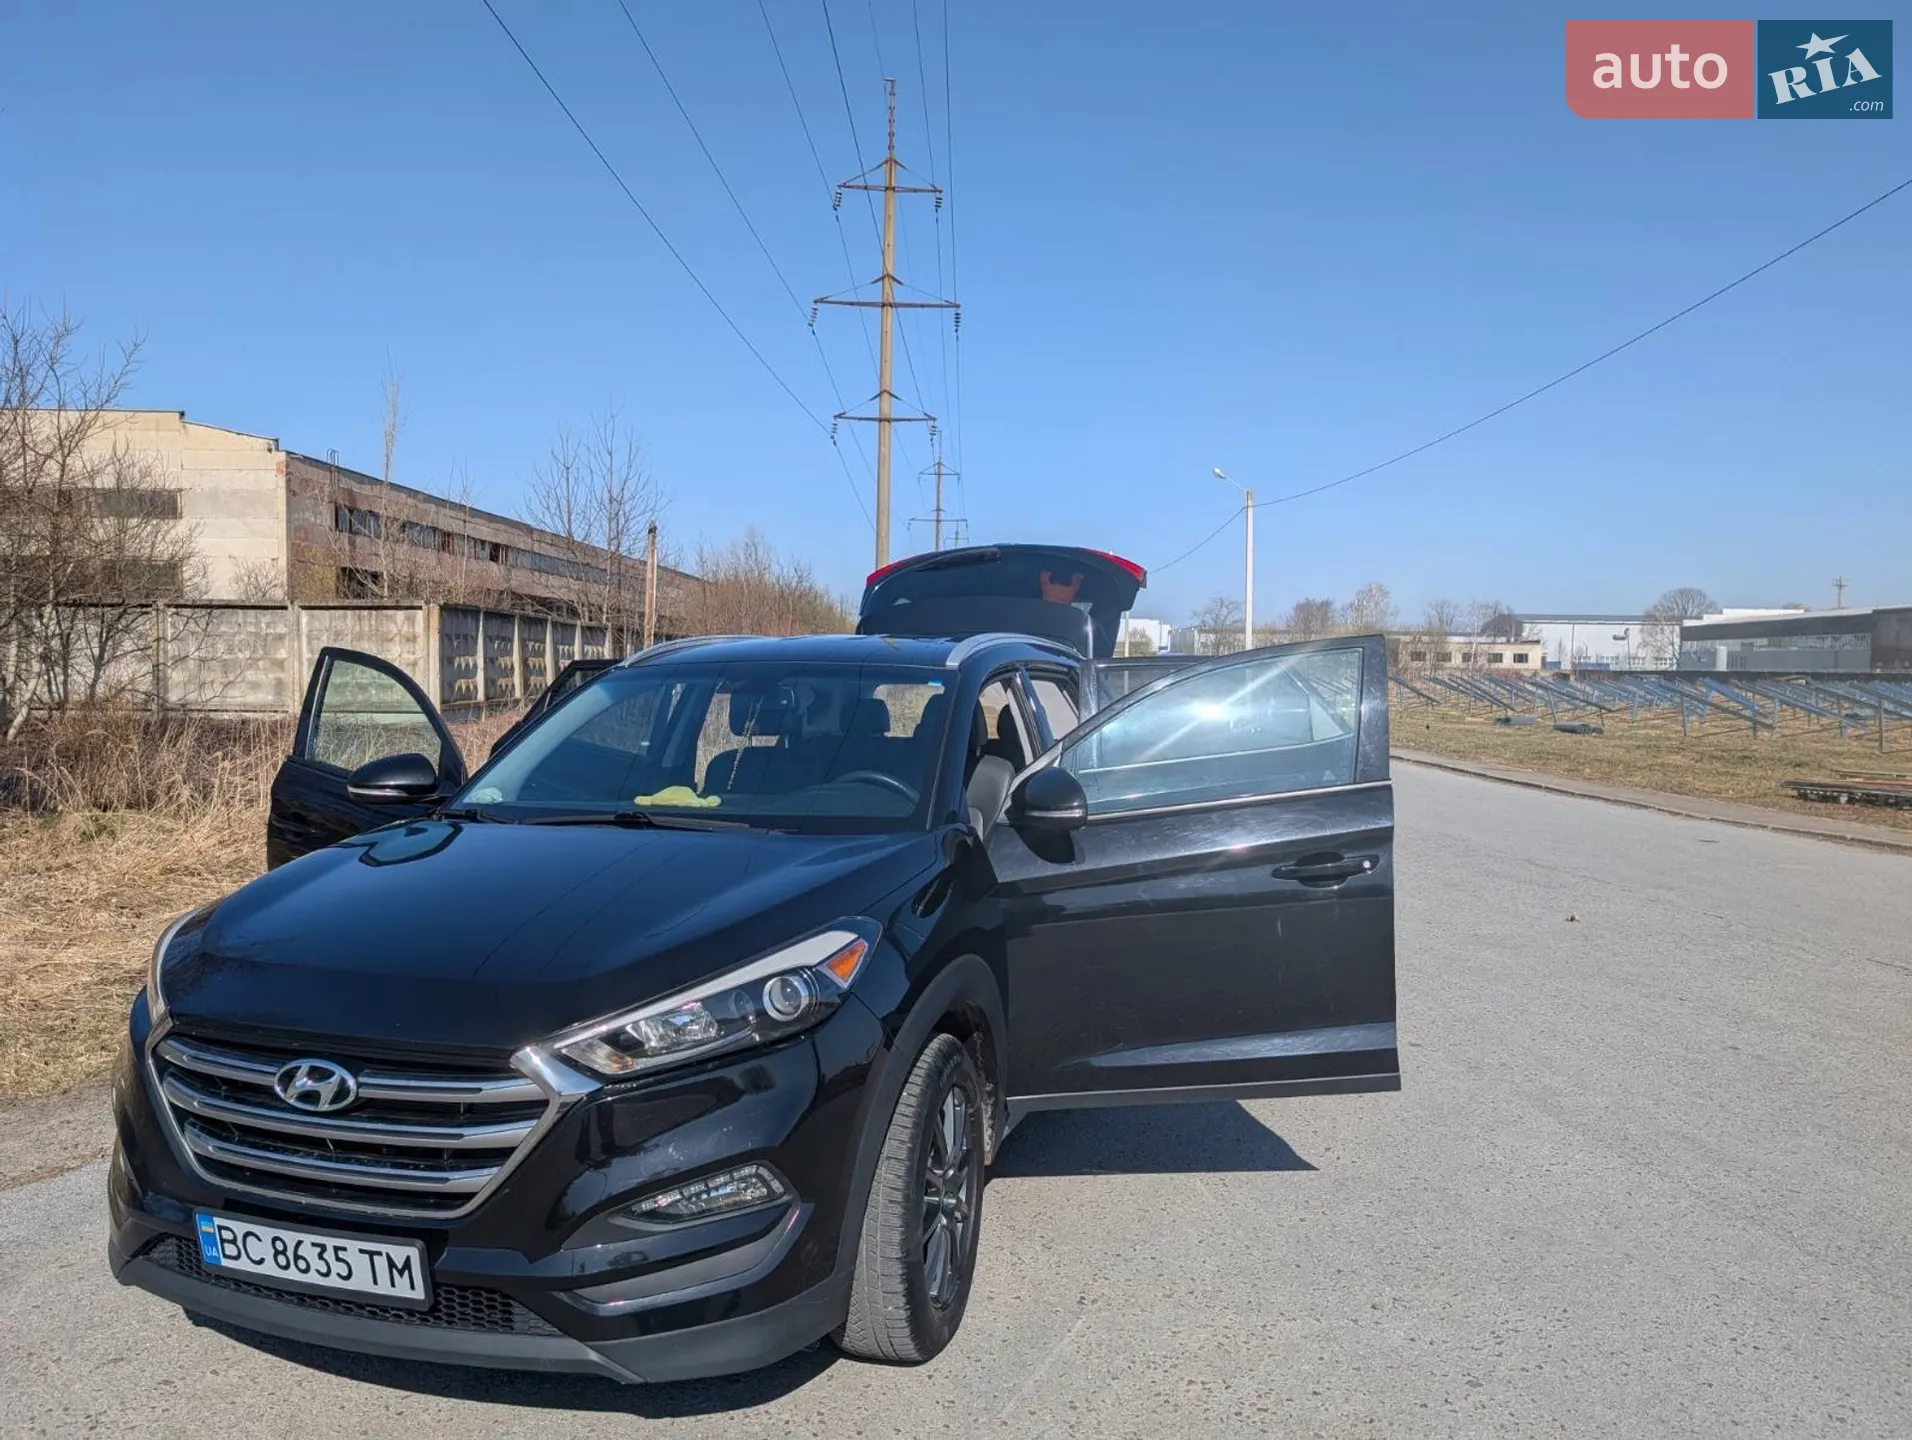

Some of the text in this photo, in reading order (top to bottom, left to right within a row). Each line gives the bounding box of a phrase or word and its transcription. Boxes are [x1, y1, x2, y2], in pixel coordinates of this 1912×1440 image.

[204, 1246, 219, 1259] UA
[216, 1224, 416, 1291] BC 8635 TM
